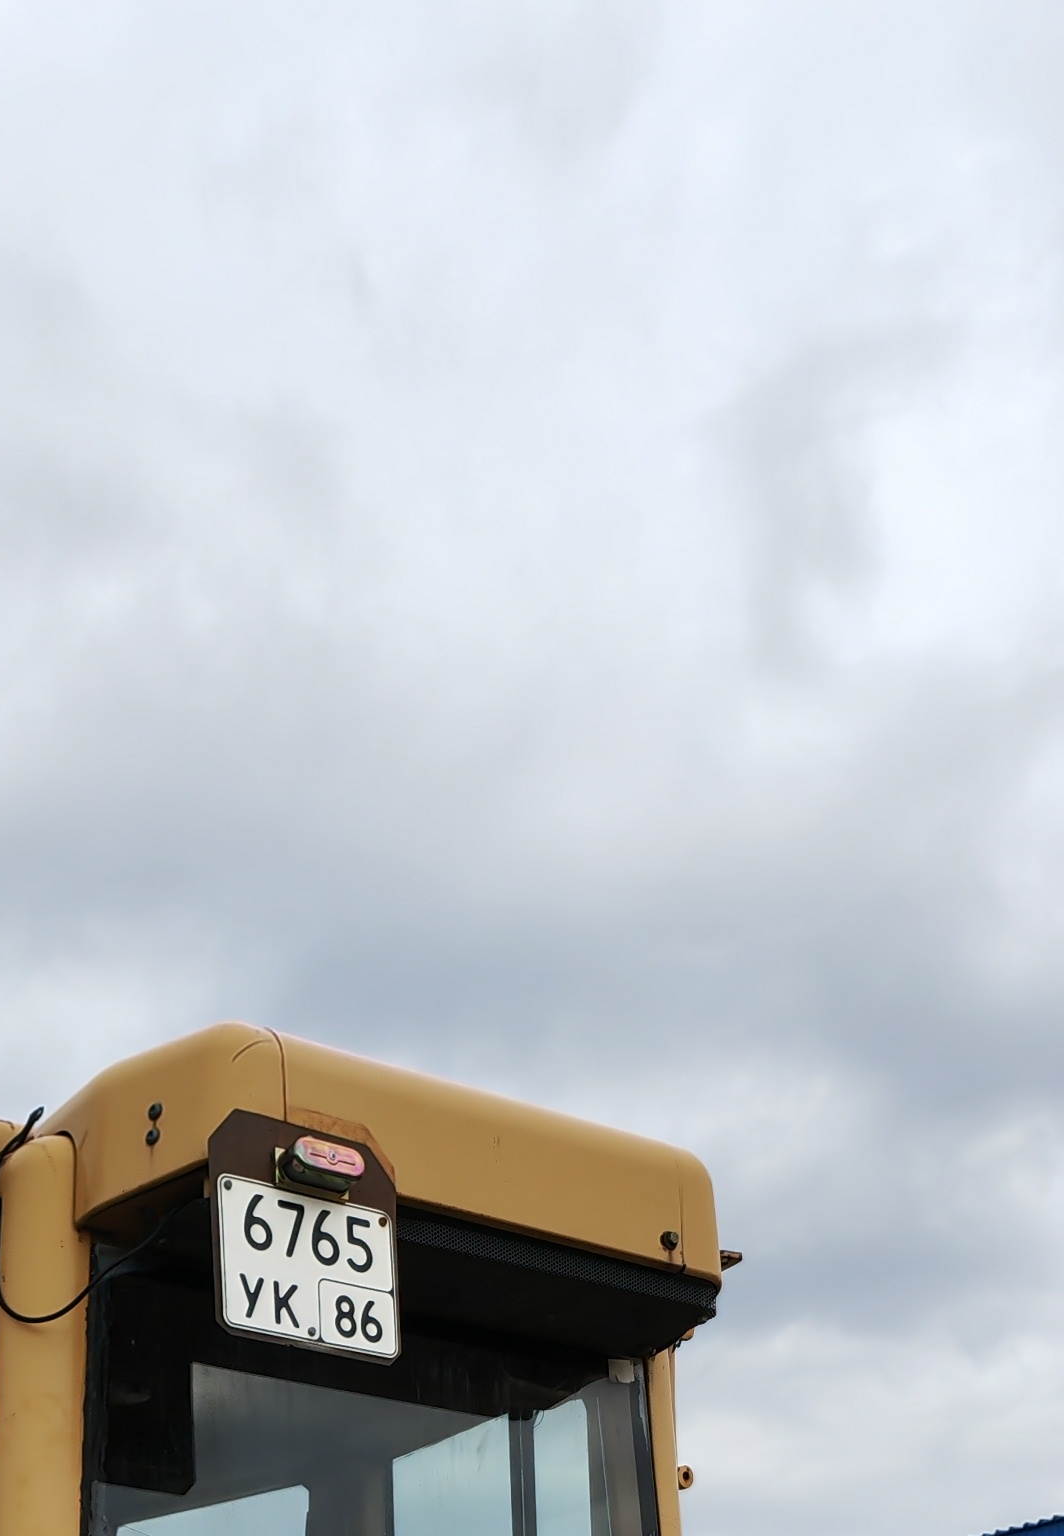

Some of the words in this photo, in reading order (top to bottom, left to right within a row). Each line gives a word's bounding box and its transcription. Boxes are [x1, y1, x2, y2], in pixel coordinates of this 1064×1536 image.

[243, 1193, 373, 1273] 6765
[239, 1272, 300, 1329] УК
[334, 1294, 383, 1343] 86
